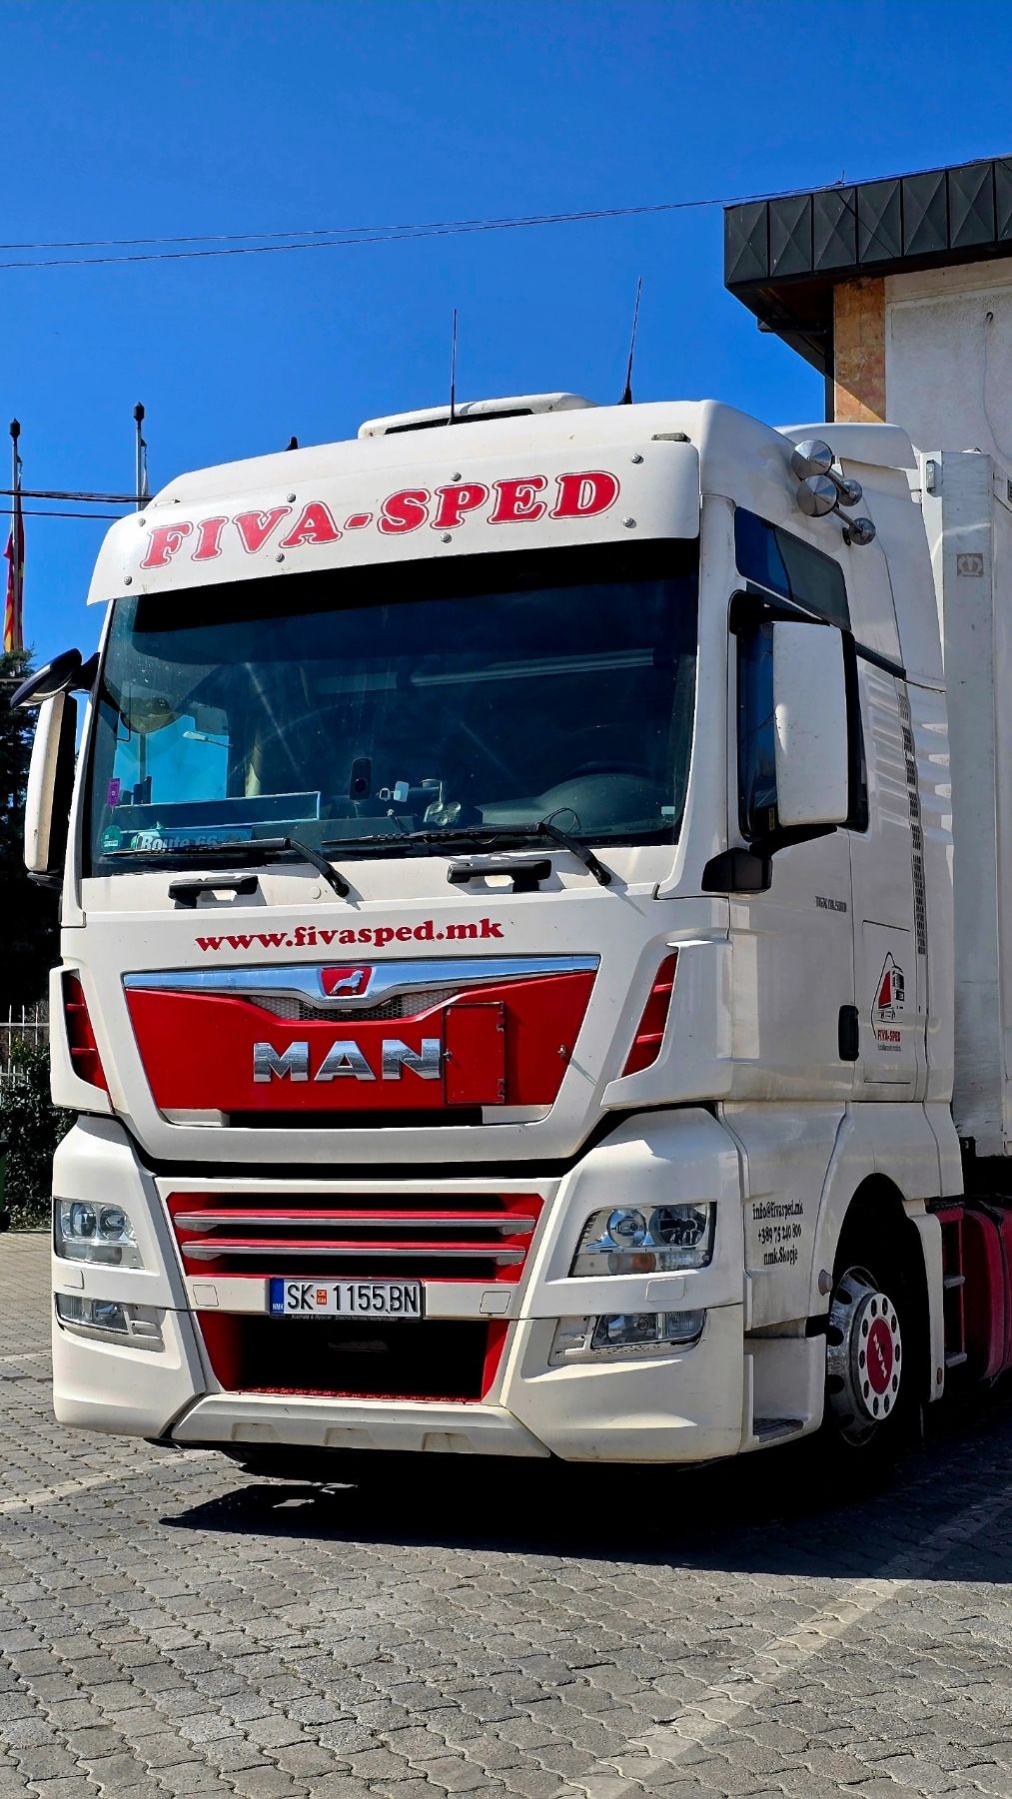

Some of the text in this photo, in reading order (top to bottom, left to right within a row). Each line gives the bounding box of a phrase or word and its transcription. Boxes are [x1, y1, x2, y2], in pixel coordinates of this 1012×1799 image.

[140, 470, 620, 569] FIVA-SPED
[195, 918, 504, 951] www.fivasped.mk
[253, 1038, 441, 1082] MAN
[287, 1284, 313, 1311] SK
